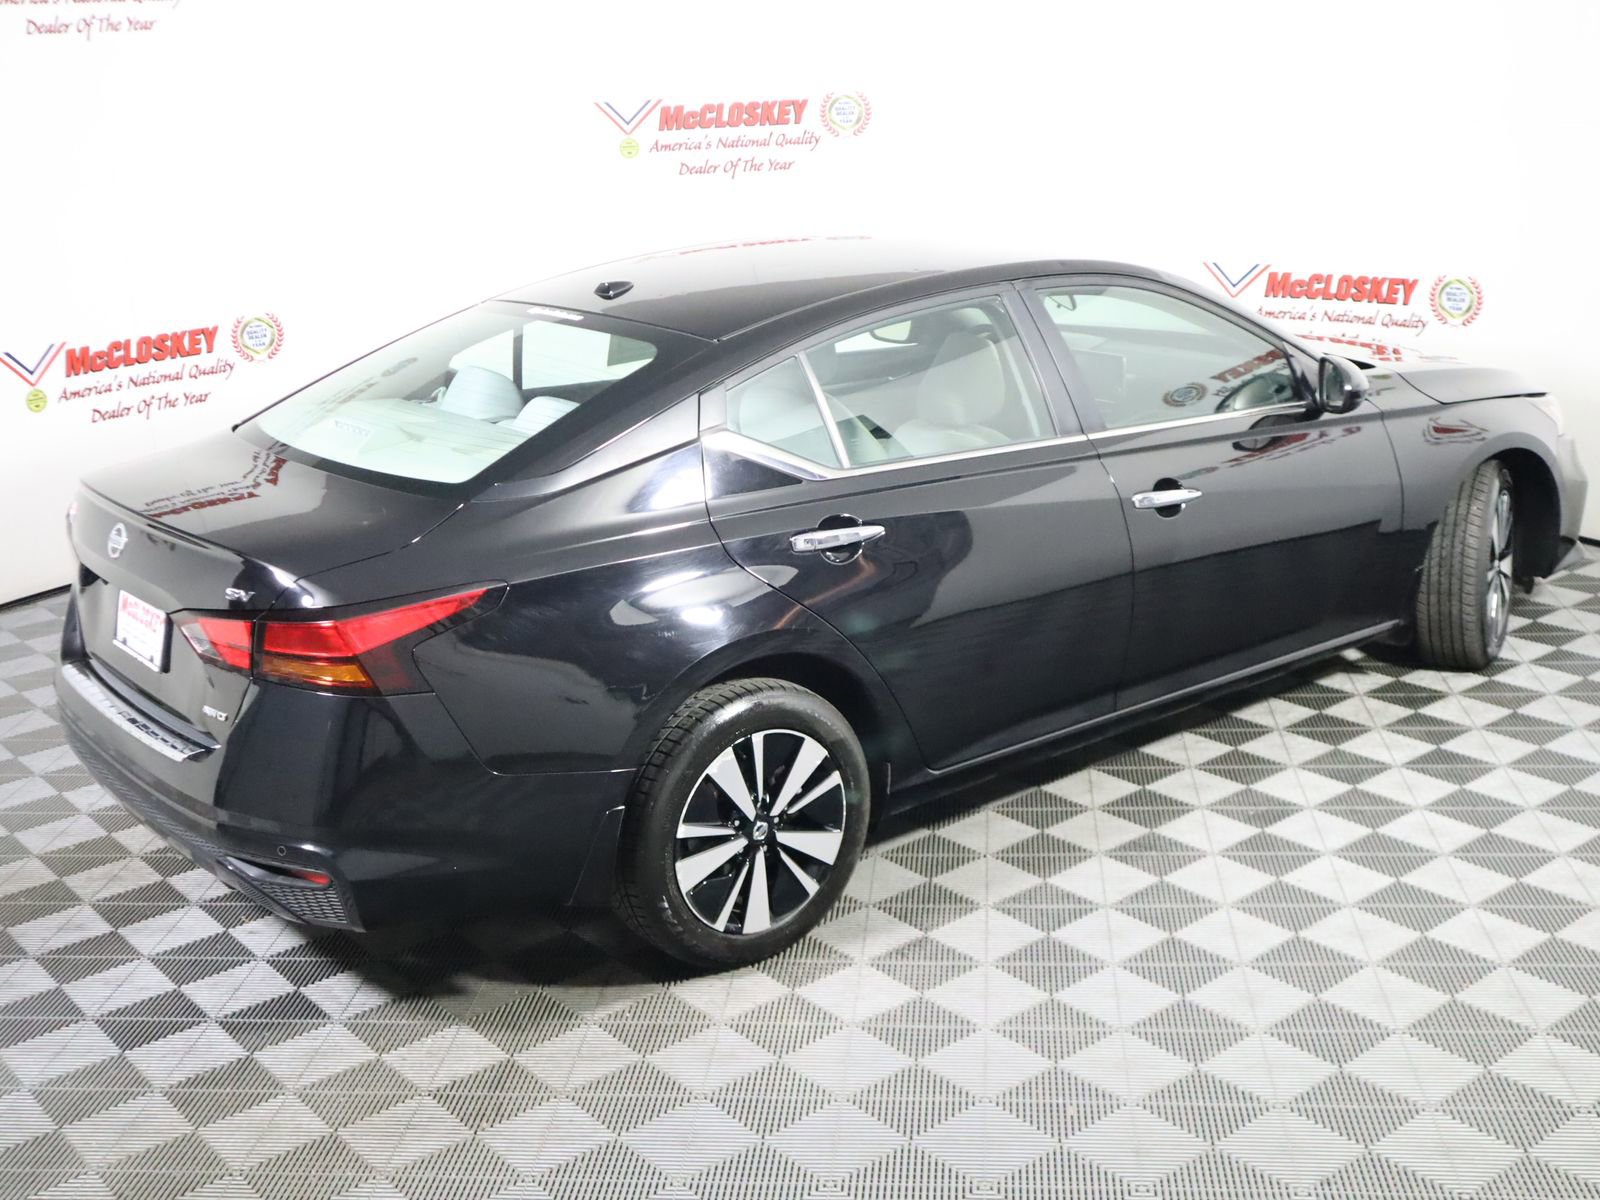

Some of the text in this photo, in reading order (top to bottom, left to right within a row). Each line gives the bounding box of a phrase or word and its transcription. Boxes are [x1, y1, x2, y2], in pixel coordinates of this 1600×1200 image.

[26, 14, 157, 41] Dealer Of The Year
[658, 98, 809, 131] McCLOSKEY
[649, 135, 712, 153] America's
[716, 131, 773, 149] National
[775, 130, 821, 151] Quality
[679, 156, 796, 180] Dealer Of The Year
[1263, 271, 1420, 306] McCLOSKEY
[1324, 308, 1378, 329] National
[1380, 312, 1429, 337] Quality
[65, 324, 219, 378] McCLOSKEY
[57, 375, 123, 403] America's
[128, 364, 184, 389] National
[188, 358, 236, 381] Quality
[91, 389, 212, 424] Dealer Of The Year
[224, 587, 257, 603] SV
